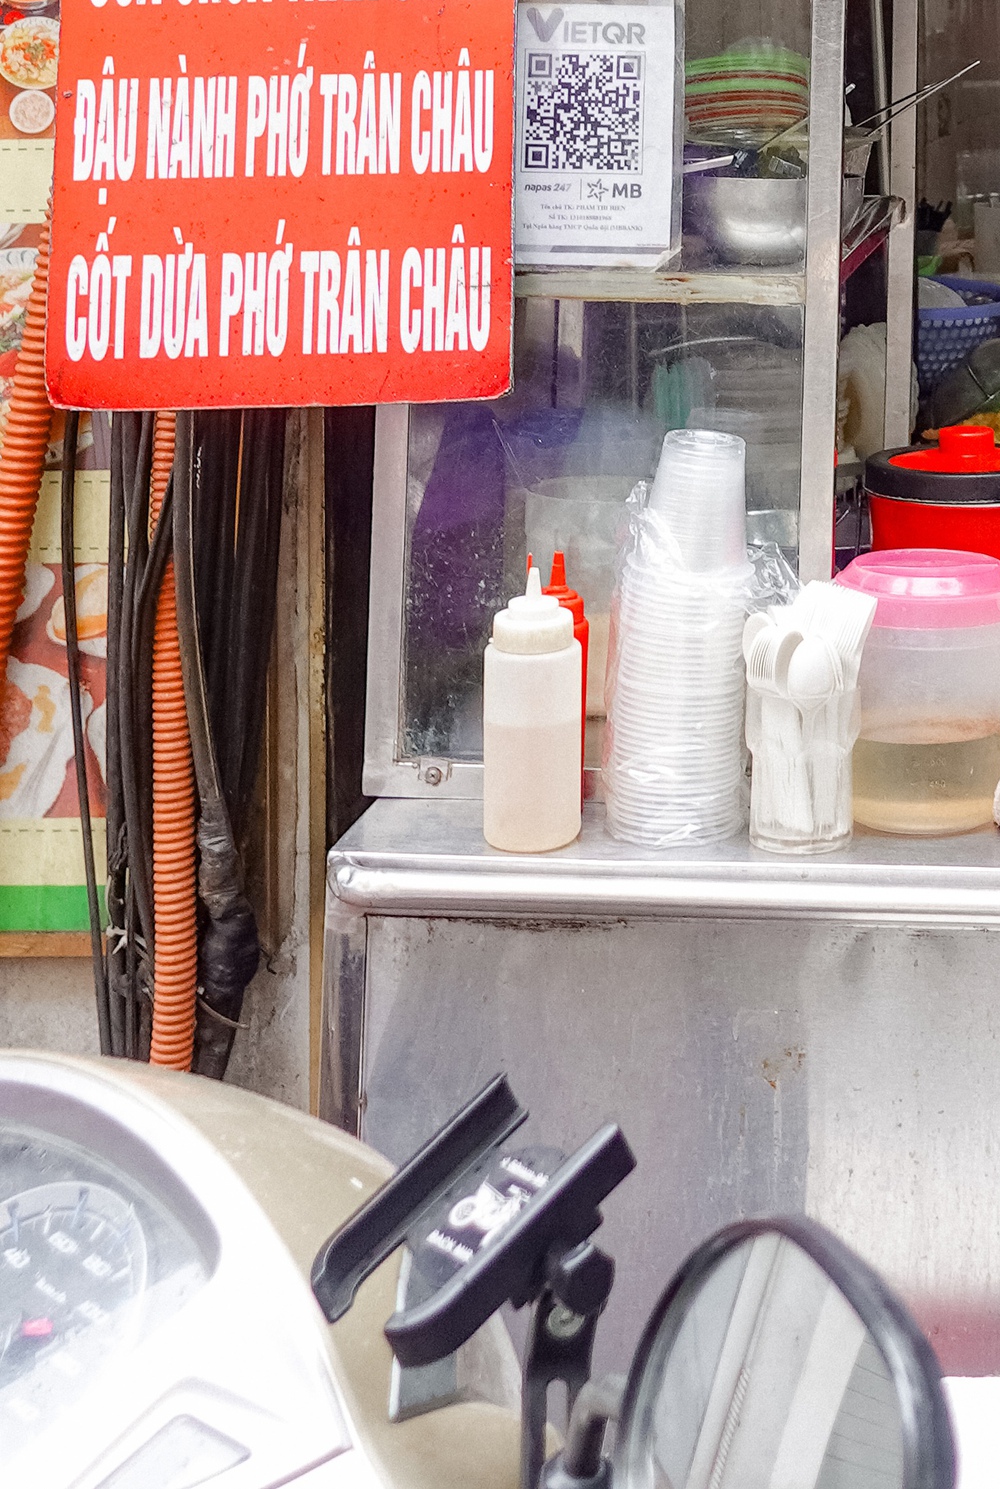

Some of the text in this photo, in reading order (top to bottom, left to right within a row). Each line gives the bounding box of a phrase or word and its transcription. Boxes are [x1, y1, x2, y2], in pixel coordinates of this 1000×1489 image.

[526, 7, 646, 44] VIETQR
[73, 43, 495, 205] ĐẬU NÀNH PHỚ TRÂN CHÂU
[524, 183, 572, 193] napas 247
[612, 183, 642, 198] MB
[66, 217, 492, 362] CỐT DỪA PHỚ TRÂN CHÂU
